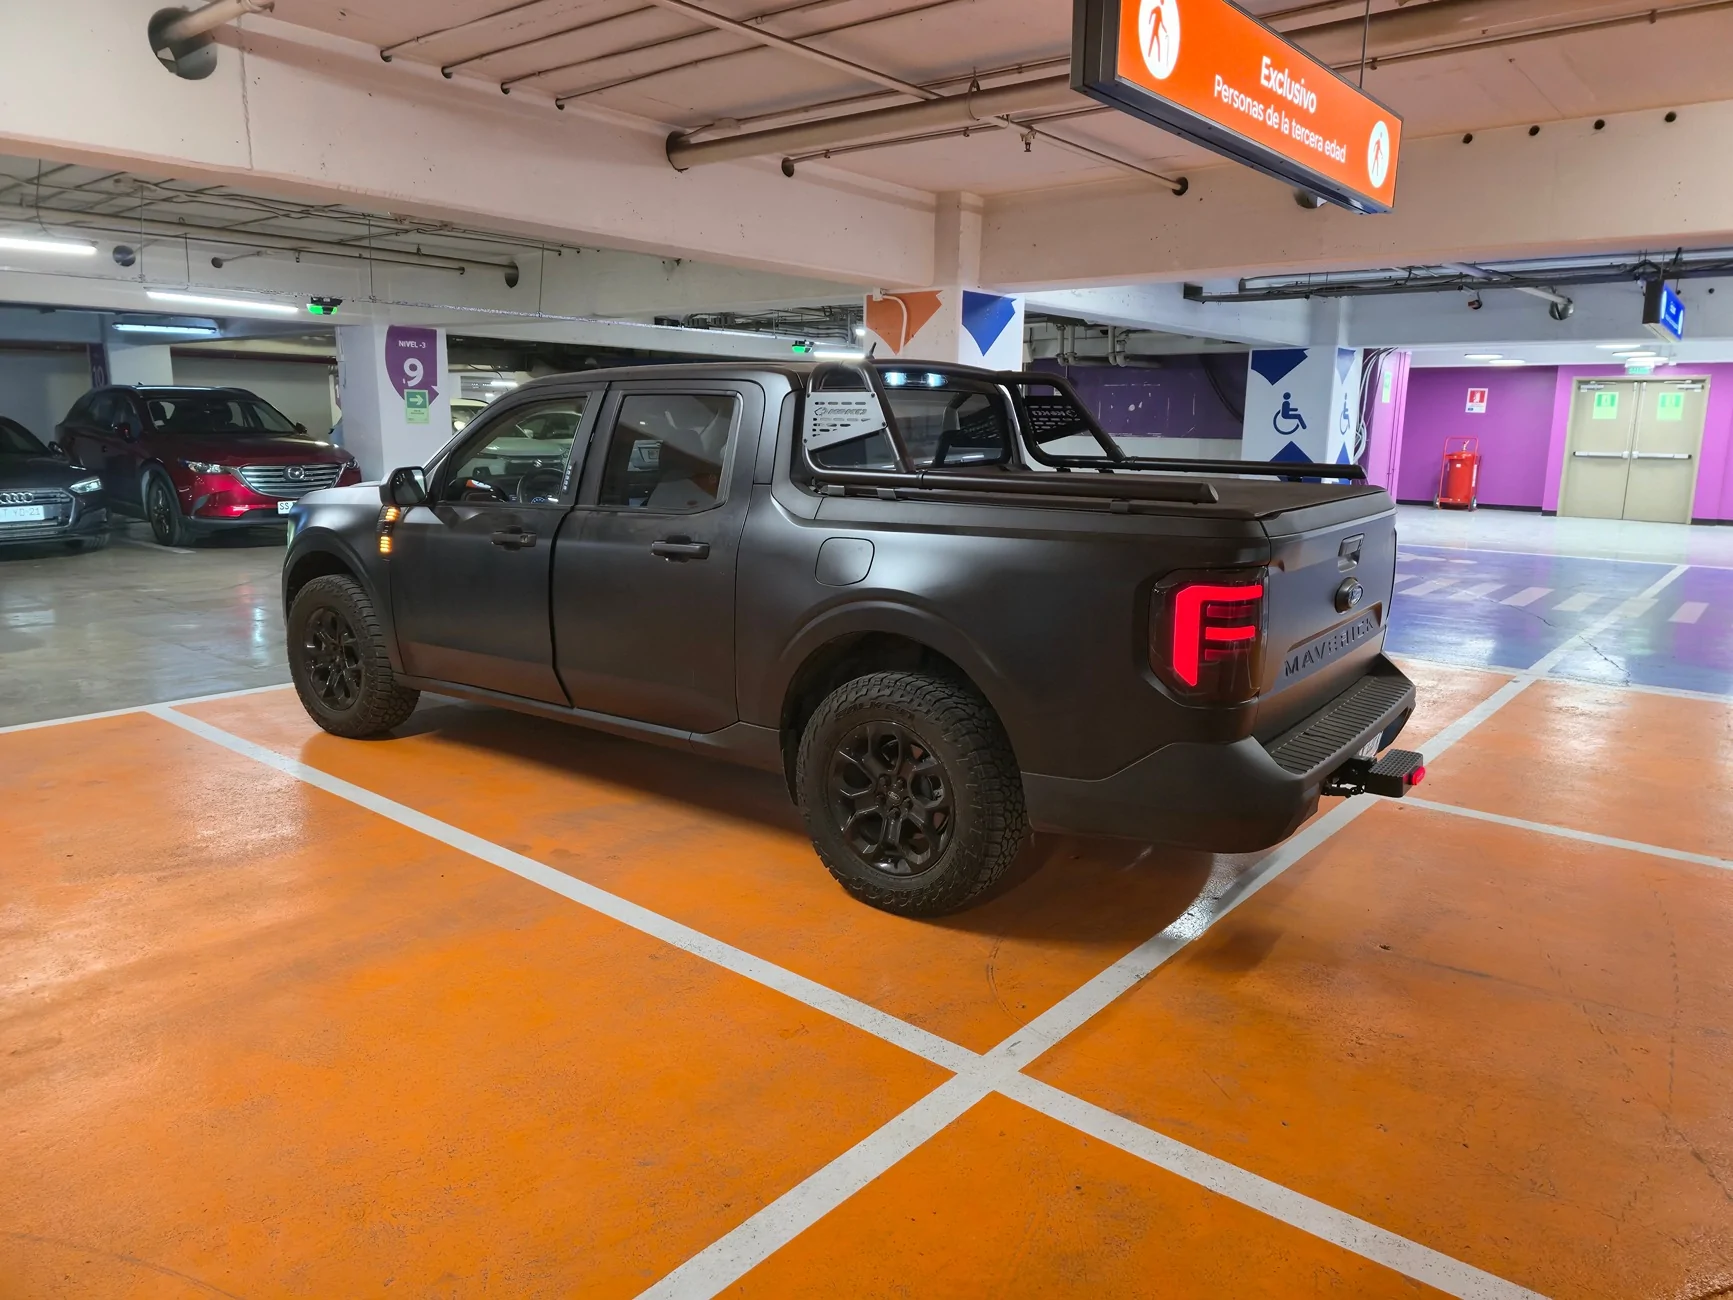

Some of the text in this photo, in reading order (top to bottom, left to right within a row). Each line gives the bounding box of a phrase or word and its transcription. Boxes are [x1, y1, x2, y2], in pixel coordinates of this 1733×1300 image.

[1260, 55, 1317, 114] Exclusivo
[1214, 74, 1347, 163] Personas de la tercera edad
[398, 340, 426, 349] NIVEL -3
[404, 357, 424, 387] 9
[1284, 618, 1374, 677] MAVERICK
